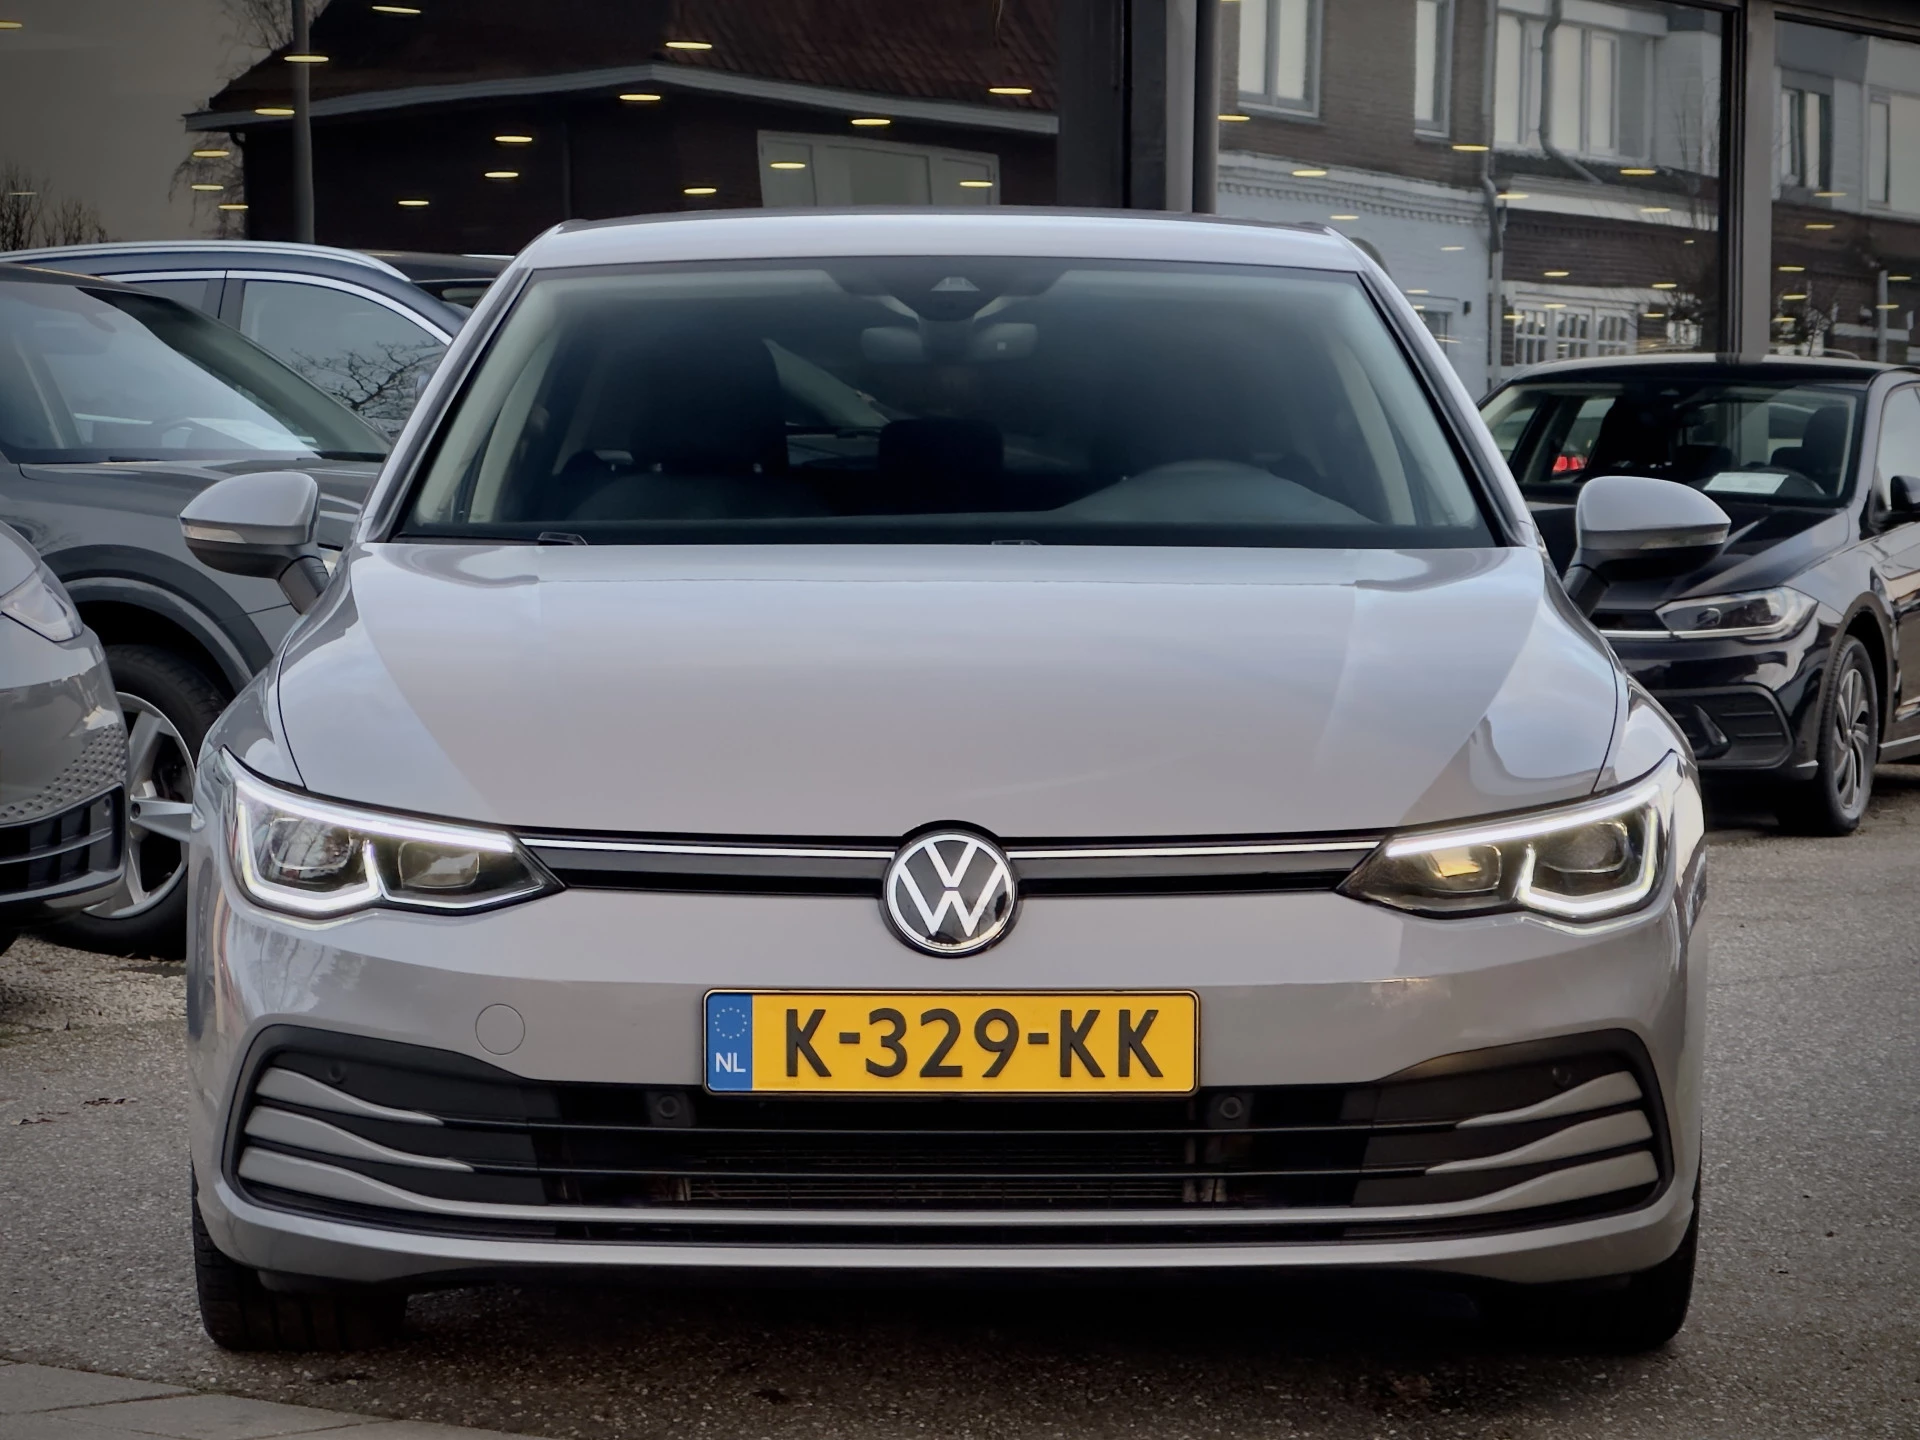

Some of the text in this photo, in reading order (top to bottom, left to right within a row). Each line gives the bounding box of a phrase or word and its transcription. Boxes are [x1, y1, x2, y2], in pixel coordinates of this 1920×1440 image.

[890, 837, 1010, 943] VW
[715, 1052, 746, 1073] NL
[785, 1008, 1164, 1078] K-329-KK
